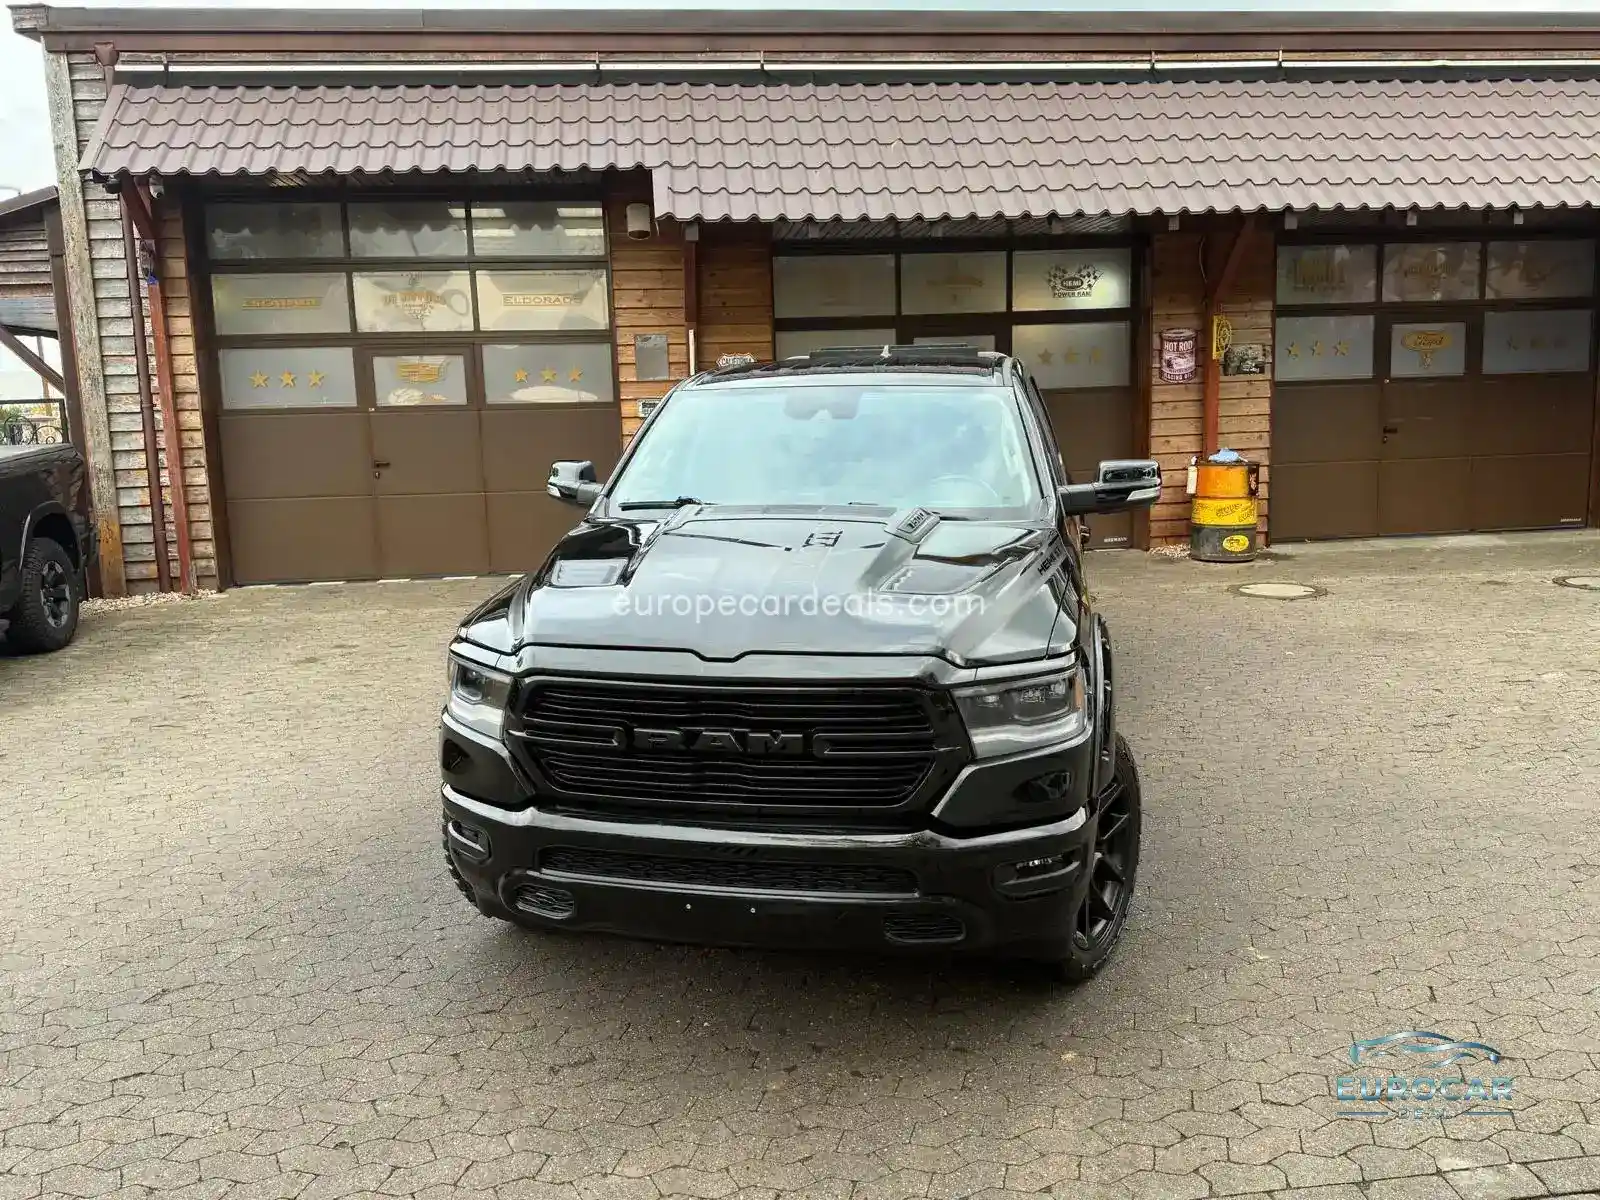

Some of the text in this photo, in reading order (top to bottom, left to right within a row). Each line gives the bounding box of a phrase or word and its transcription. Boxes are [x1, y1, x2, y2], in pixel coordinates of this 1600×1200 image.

[1062, 279, 1082, 287] HEMI
[502, 294, 584, 306] ELDORADO
[1053, 291, 1076, 299] POWER
[1164, 340, 1193, 352] HOT ROD
[633, 727, 804, 754] RAM
